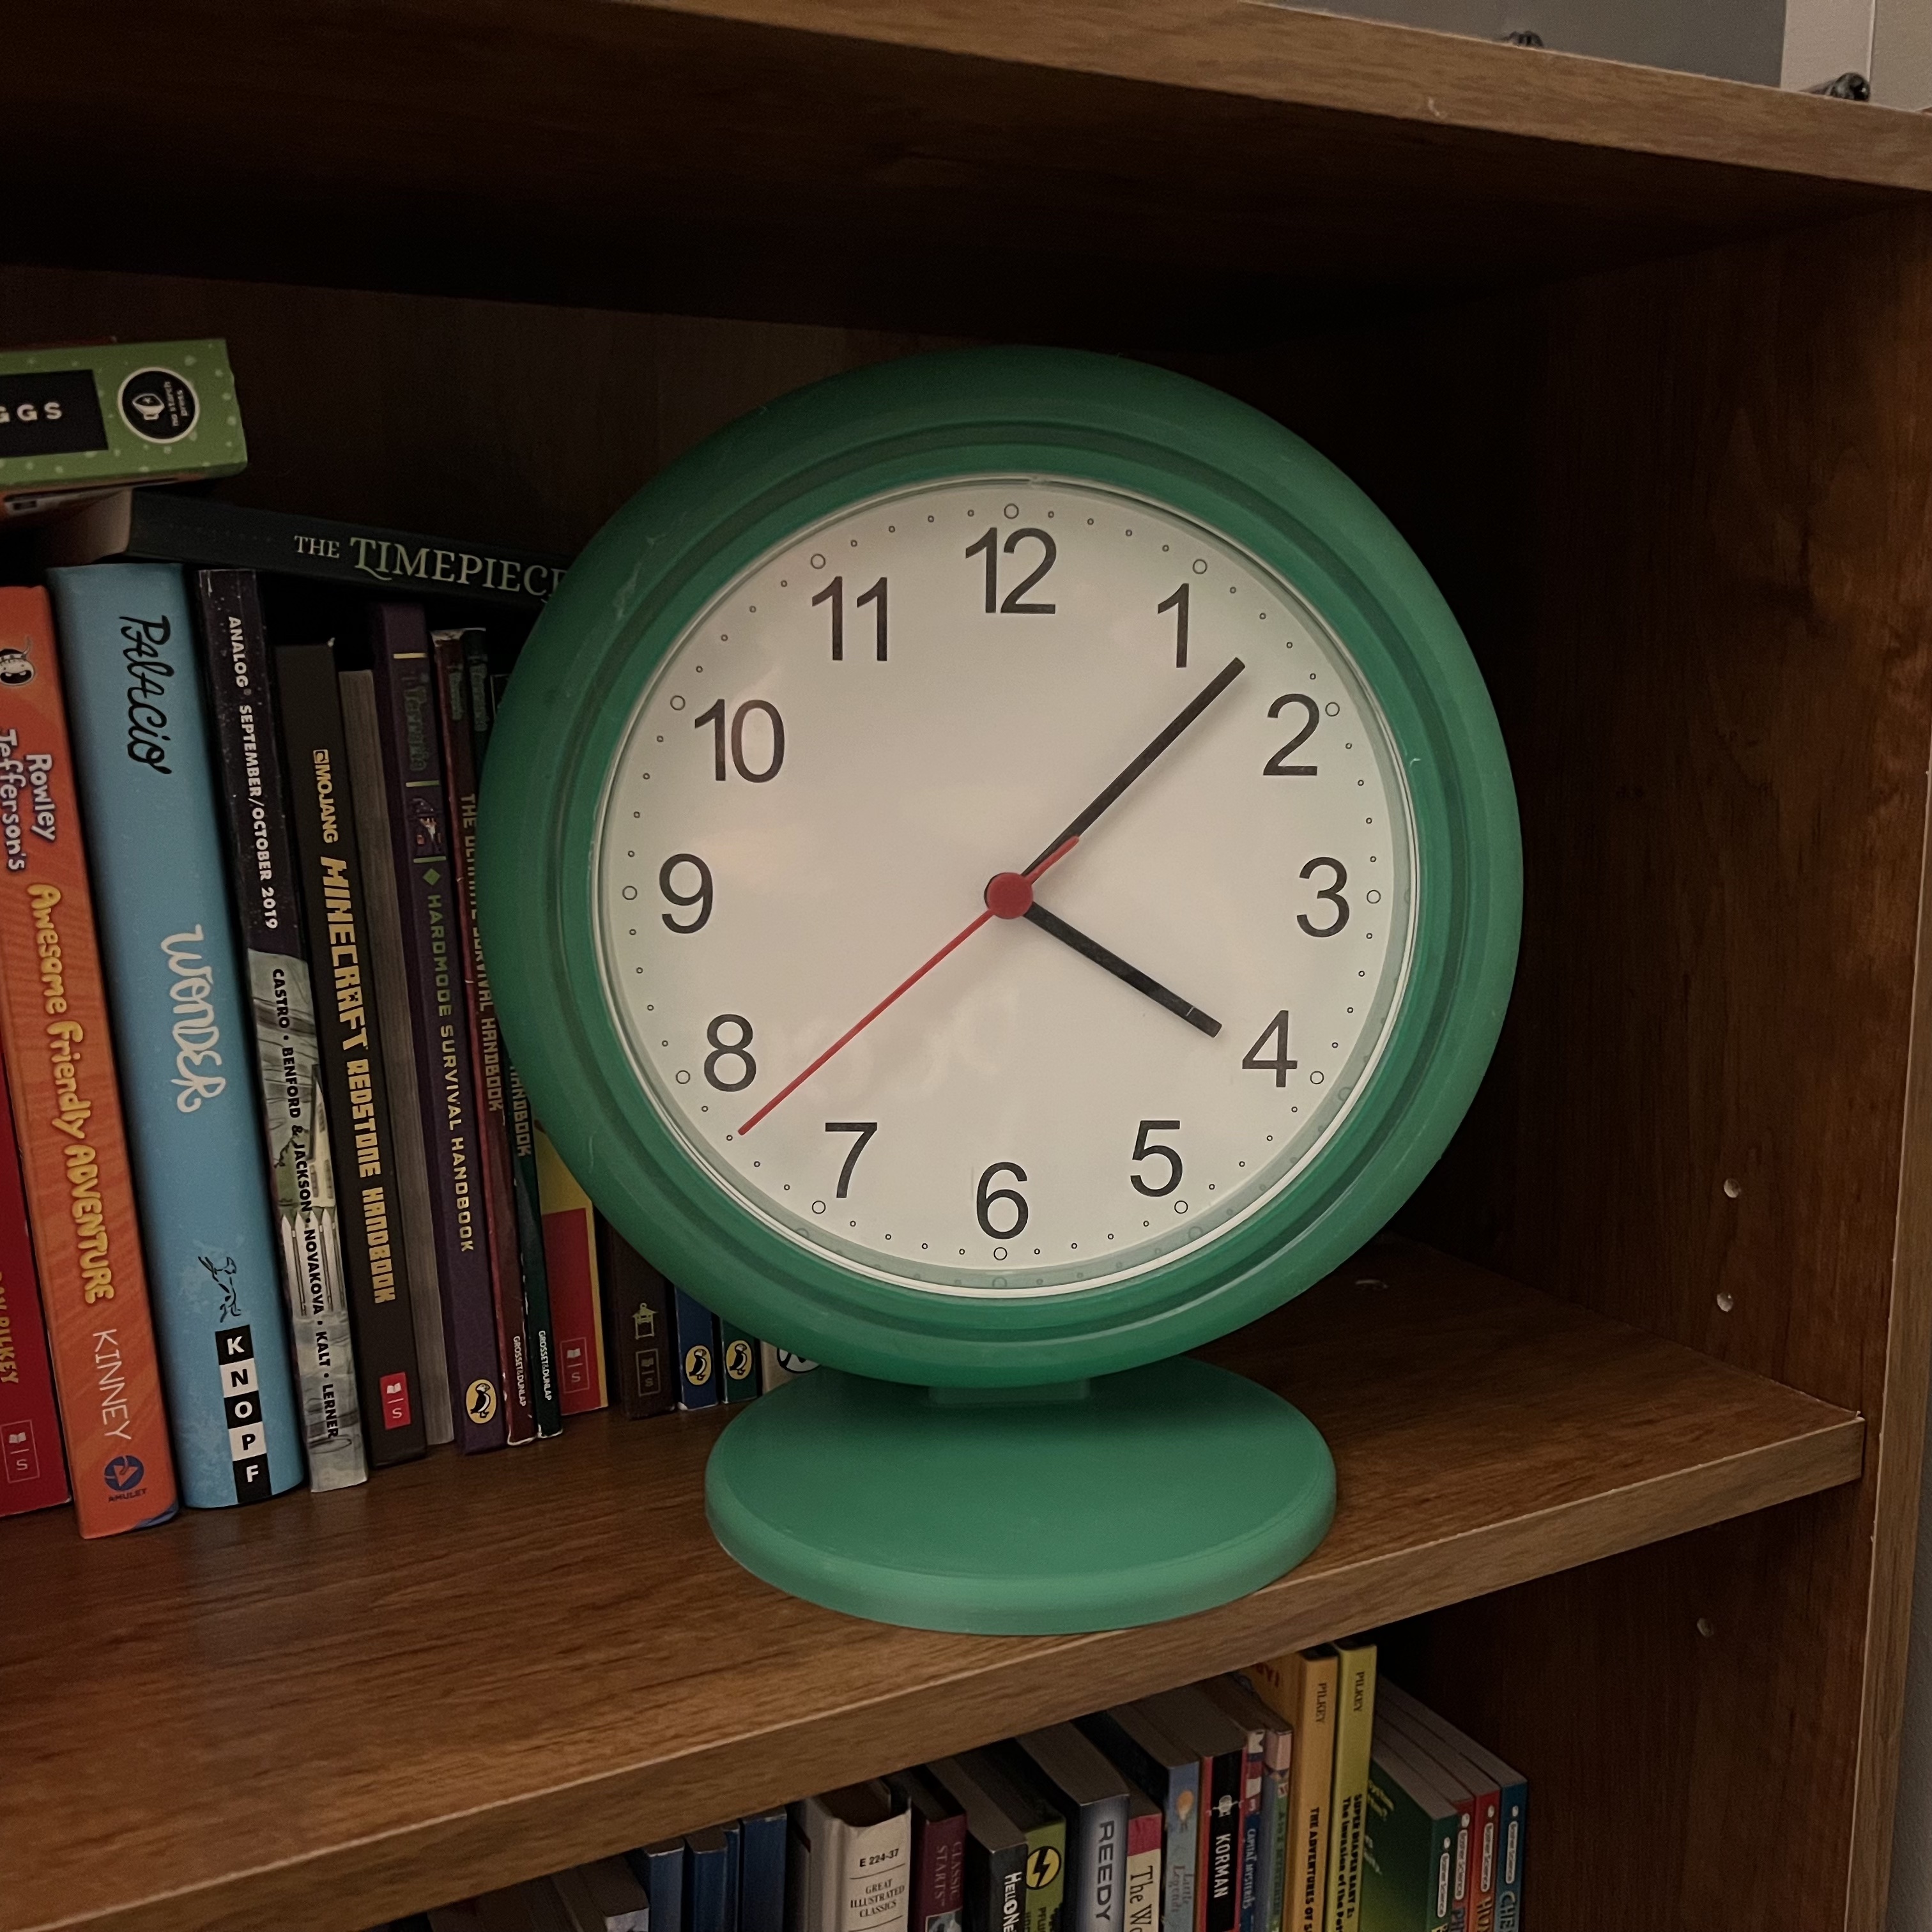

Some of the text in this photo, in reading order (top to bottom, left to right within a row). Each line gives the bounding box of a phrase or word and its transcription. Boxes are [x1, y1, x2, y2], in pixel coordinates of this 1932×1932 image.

[293, 534, 341, 559] THE
[965, 526, 1057, 615] 12
[811, 576, 888, 662] 11
[1157, 583, 1190, 668] 1
[694, 698, 785, 783] 10
[1262, 693, 1320, 776] 2
[24, 753, 56, 842] Rowley
[238, 704, 274, 884] SEPTEMBER/OCTOBER
[259, 885, 279, 931] 2019
[313, 763, 339, 844] MOJANG
[659, 853, 714, 934] 9
[1296, 856, 1350, 938] 3
[461, 793, 477, 829] THE
[482, 1018, 503, 1112] HANDBOOK
[272, 967, 291, 1029] CASTRO
[282, 1045, 301, 1119] BENFORD
[320, 855, 397, 1305] MINECRAFT REDSTONE HANDBOOK
[427, 894, 475, 1252] HARDMODE SURVIVAL HANDBOOK
[703, 1013, 756, 1092] 8
[1241, 1009, 1298, 1088] 4
[26, 882, 116, 1306] Awesome Friendly ADVENTURE
[293, 1142, 312, 1213] JACKSON
[825, 1122, 878, 1199] 7
[1130, 1120, 1183, 1197] 5
[976, 1162, 1029, 1239] 6
[304, 1228, 323, 1317] NOVAKOVA
[92, 1327, 132, 1441] KINNEY
[315, 1329, 331, 1367] KALT
[226, 1334, 260, 1485] KNOPF
[321, 1382, 339, 1439] LERNER
[1315, 1682, 1328, 1724] PILKEY
[1353, 1671, 1365, 1712] PILKEY
[1309, 1807, 1319, 1828] THE
[1342, 1796, 1351, 1818] The
[1353, 1793, 1362, 1830] SUPER
[859, 1848, 900, 1867] E 224-37
[949, 1841, 962, 1901] CLASSIC
[1096, 1820, 1115, 1922] REEDY
[1213, 1833, 1232, 1899] KORMAN
[1305, 1831, 1318, 1905] ADVENTURES
[1338, 1874, 1347, 1887] of
[1339, 1821, 1350, 1873] Invasion
[1350, 1832, 1361, 1873] DIAPER
[850, 1885, 905, 1909] ILLUSTRATED
[859, 1899, 898, 1919] CLASSICS
[865, 1878, 893, 1895] GREAT
[1130, 1865, 1153, 1905] The
[1304, 1906, 1314, 1920] OF
[1338, 1889, 1346, 1910] the
[1347, 1874, 1358, 1903] BABY
